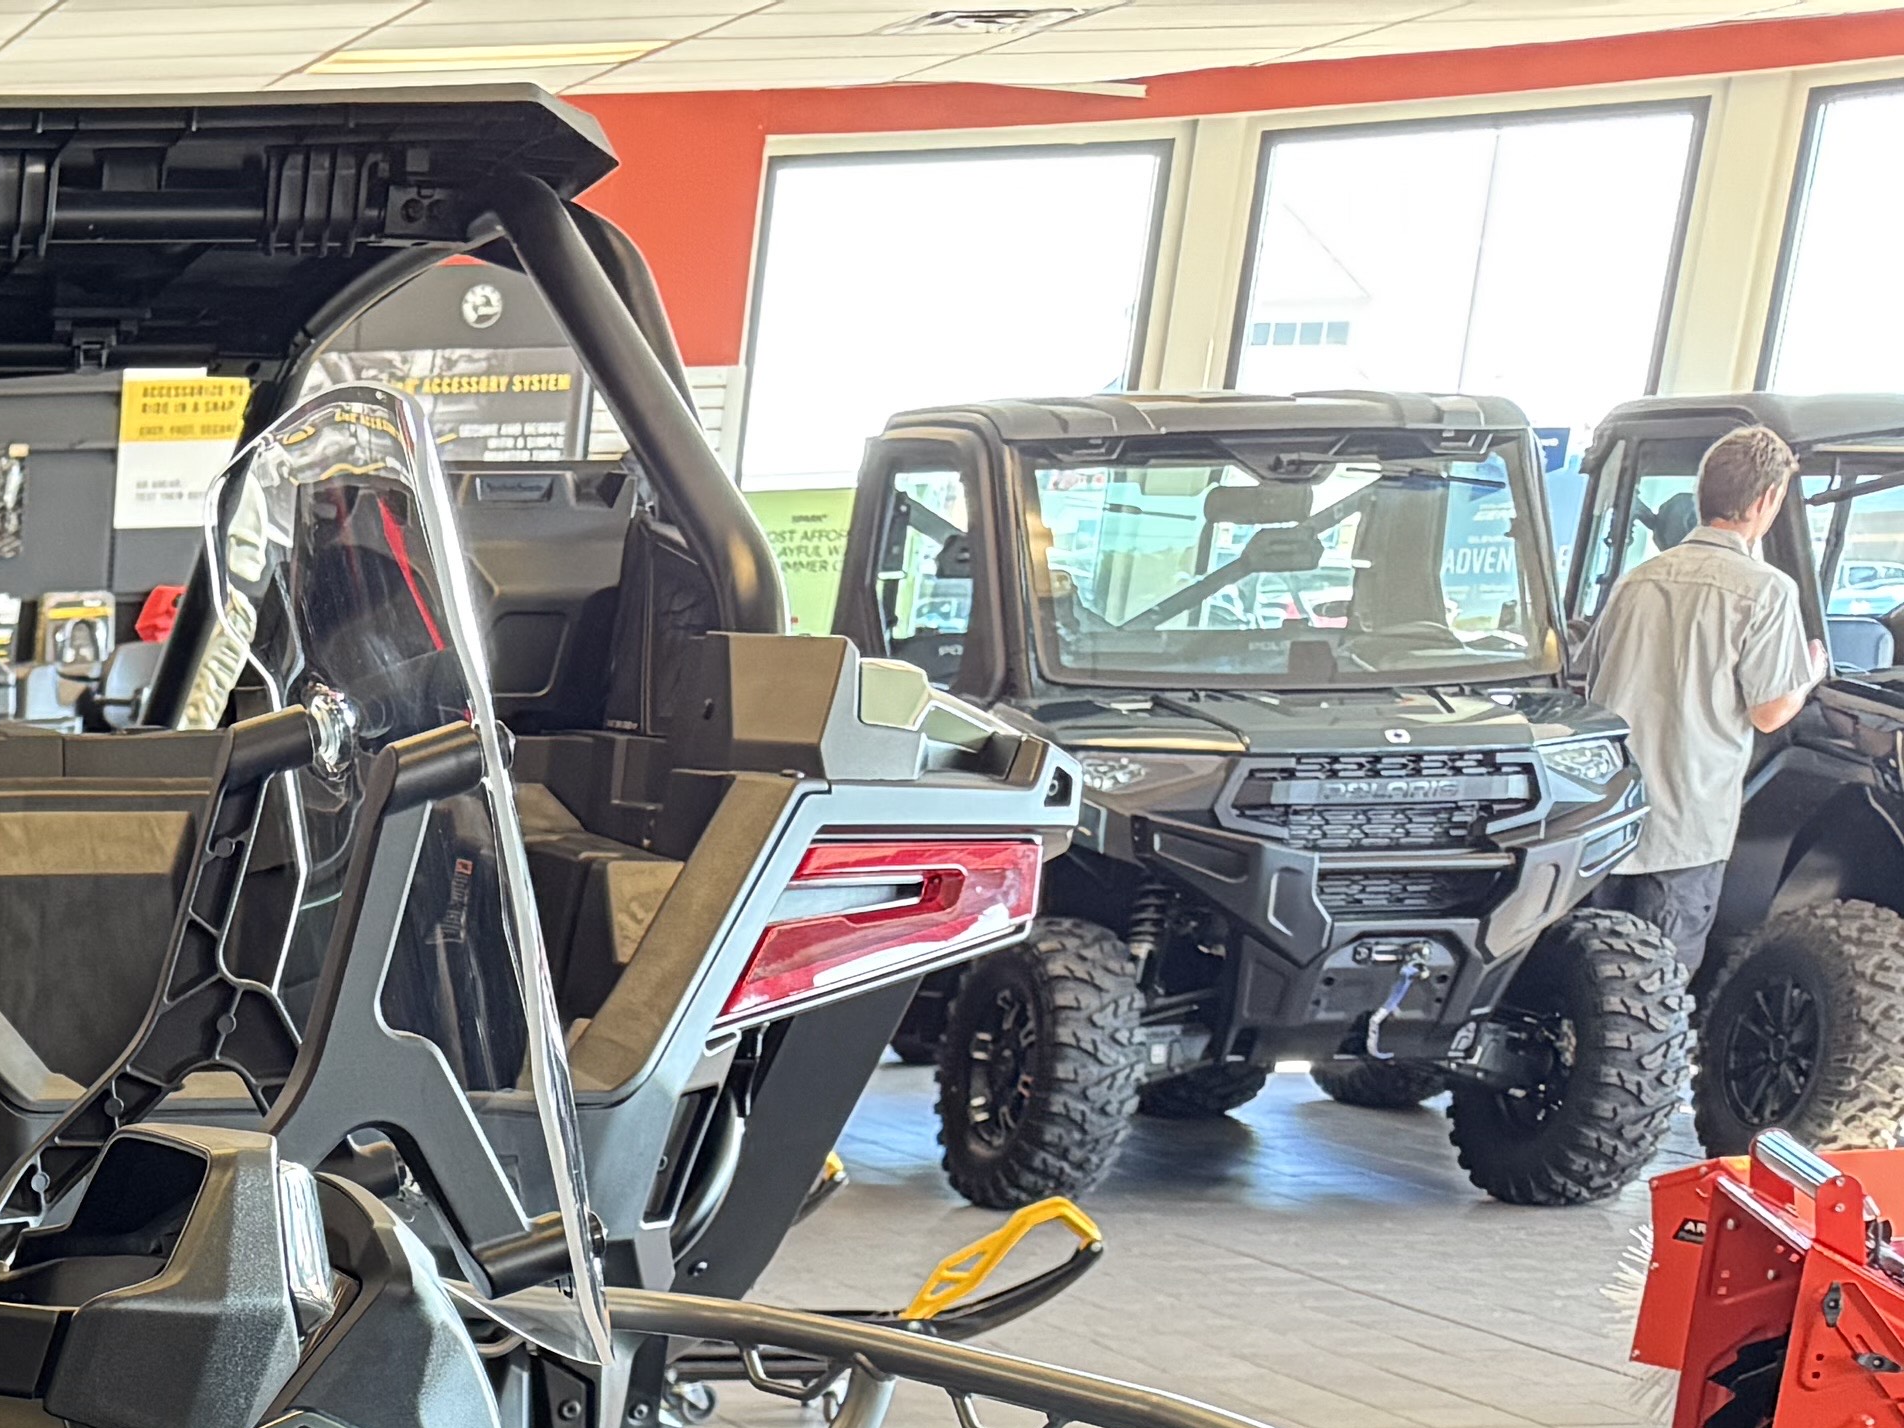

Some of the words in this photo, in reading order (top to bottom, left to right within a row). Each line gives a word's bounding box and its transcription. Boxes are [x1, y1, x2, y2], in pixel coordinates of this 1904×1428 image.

[423, 376, 509, 394] ACCESSORY
[512, 373, 572, 393] SYSTEM
[204, 400, 236, 412] SNAP
[1322, 779, 1460, 799] POLARIS
